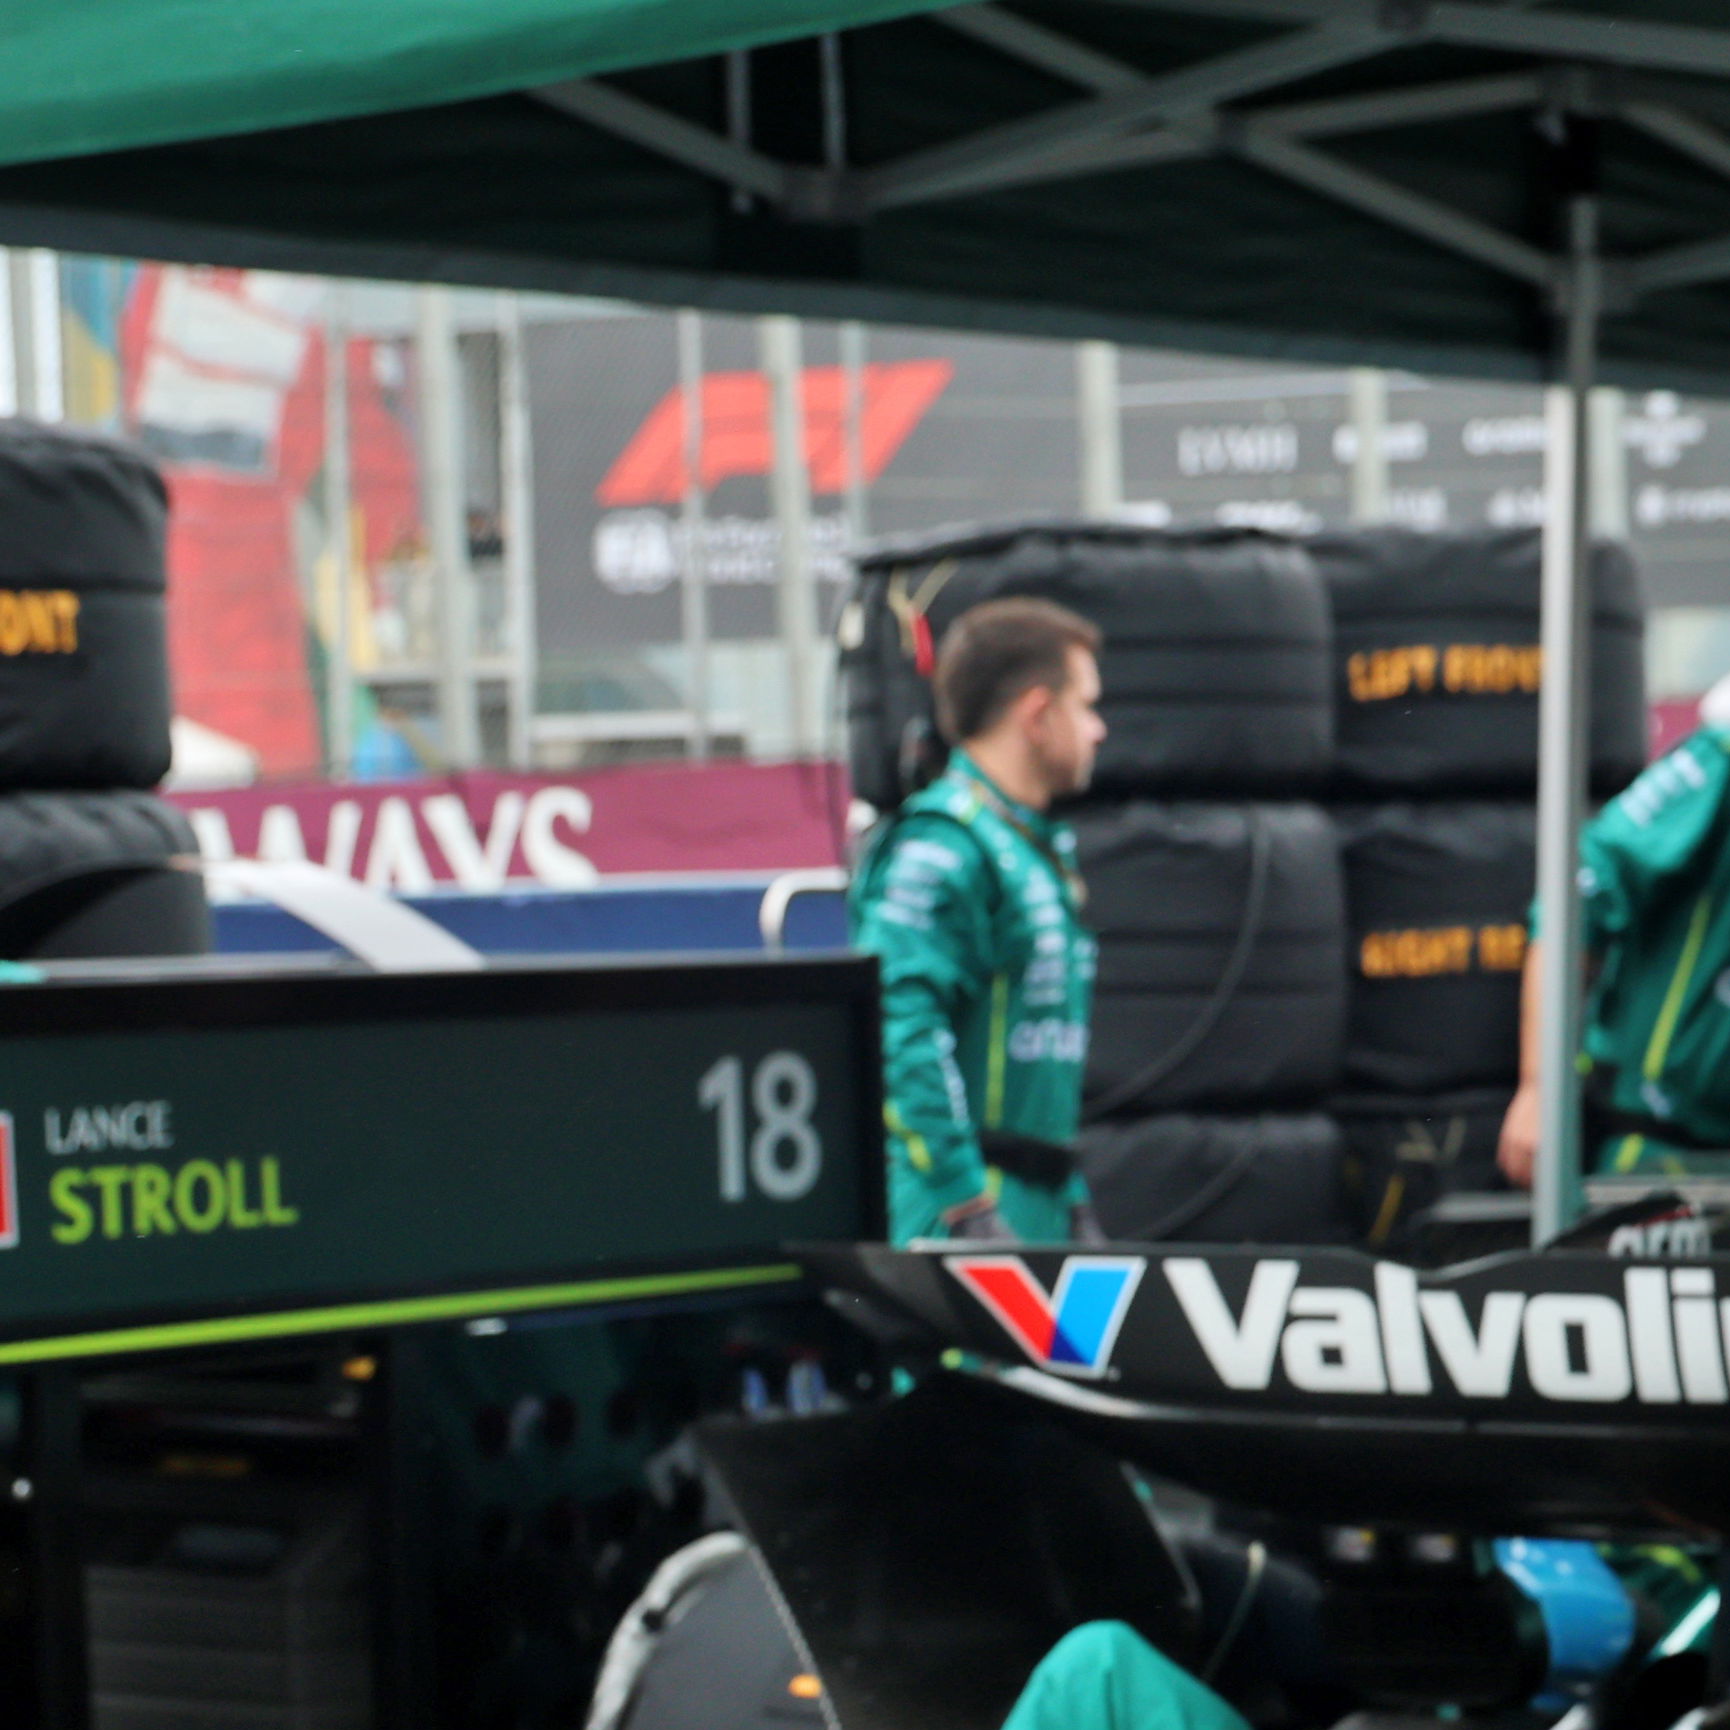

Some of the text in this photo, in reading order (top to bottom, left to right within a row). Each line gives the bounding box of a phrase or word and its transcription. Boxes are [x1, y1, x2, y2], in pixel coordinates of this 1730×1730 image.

[1443, 645, 1543, 694] FRON
[44, 1098, 176, 1156] LANCE
[698, 1052, 823, 1203] 18
[49, 1153, 299, 1245] STROLL
